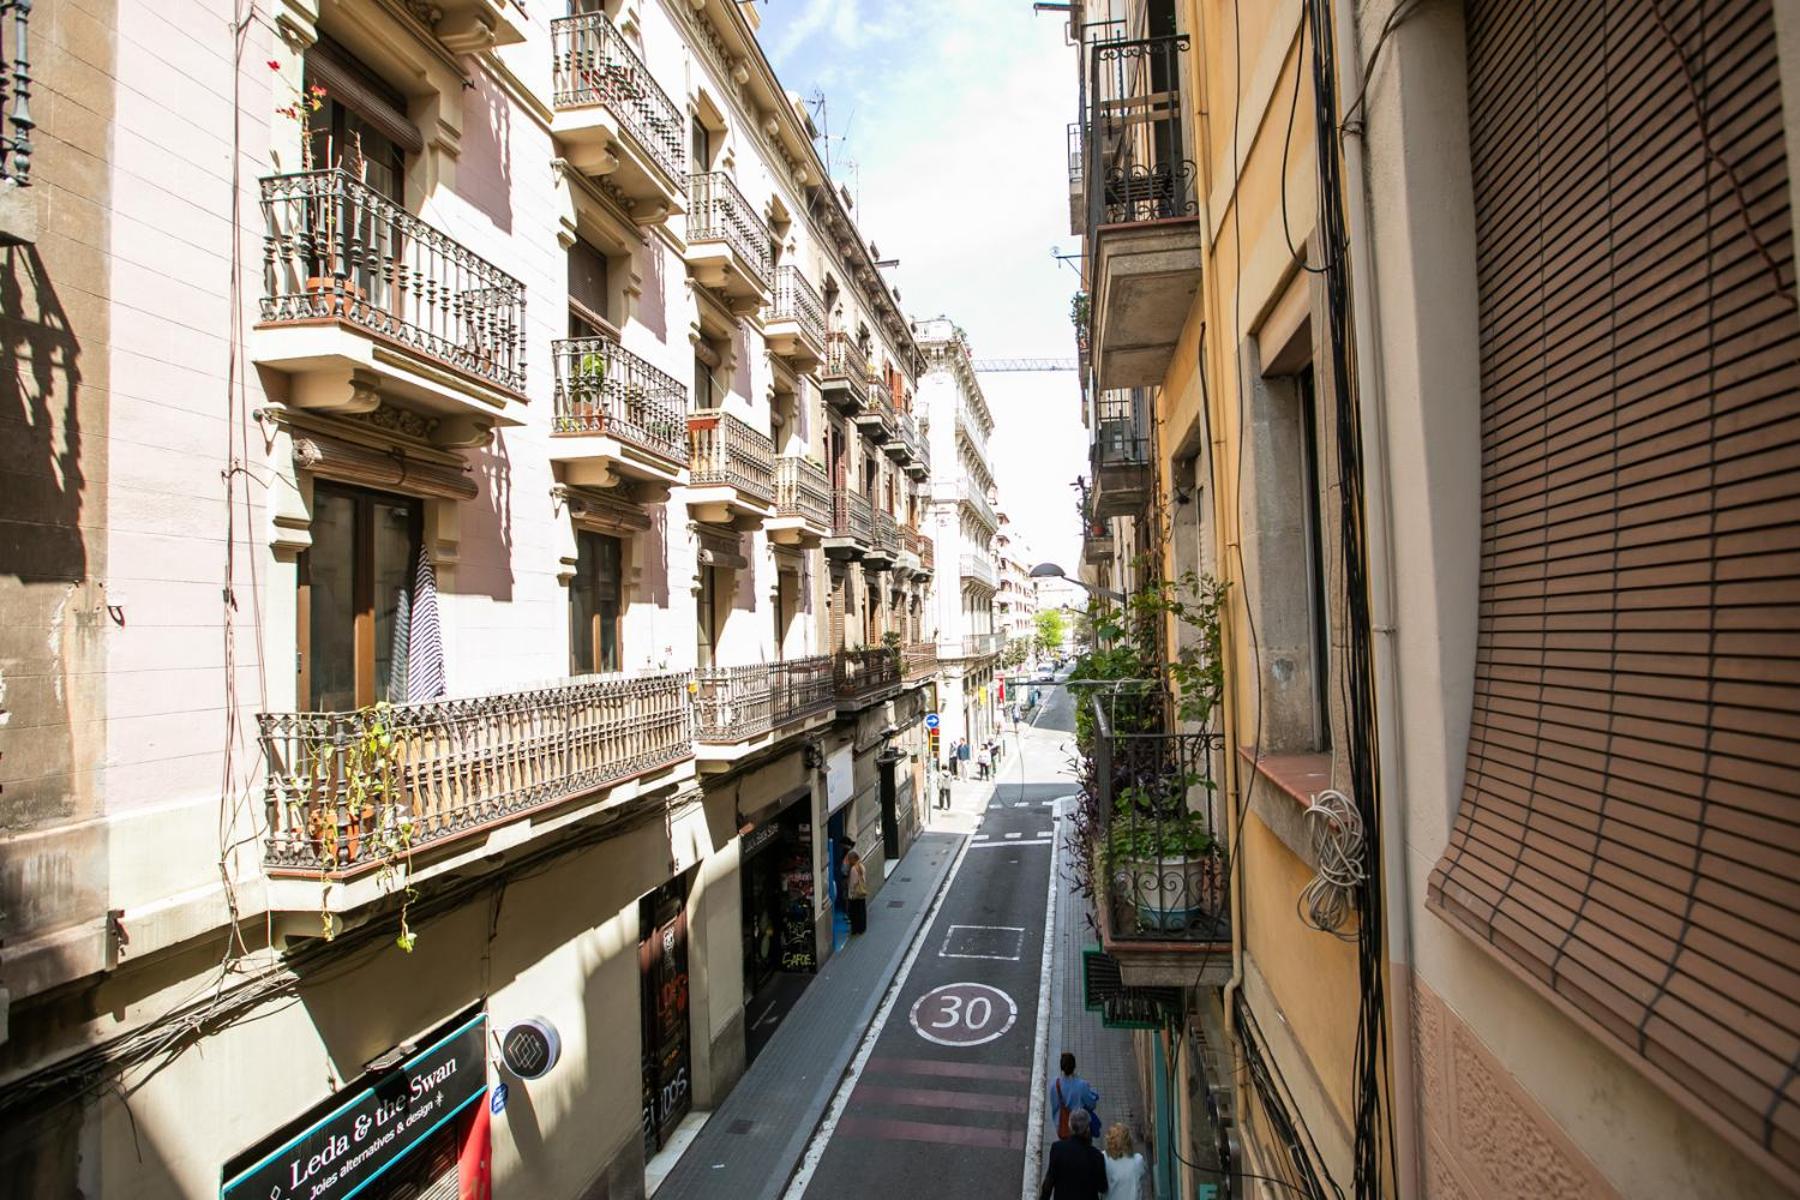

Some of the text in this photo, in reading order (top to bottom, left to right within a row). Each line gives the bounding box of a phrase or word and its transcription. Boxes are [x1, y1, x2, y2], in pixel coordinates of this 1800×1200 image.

[931, 995, 992, 1030] 30
[289, 1134, 350, 1190] Leda
[354, 1114, 372, 1142] &
[375, 1094, 406, 1127] the
[410, 1058, 457, 1103] Swan
[310, 1100, 433, 1200] Joies alternatives & design
